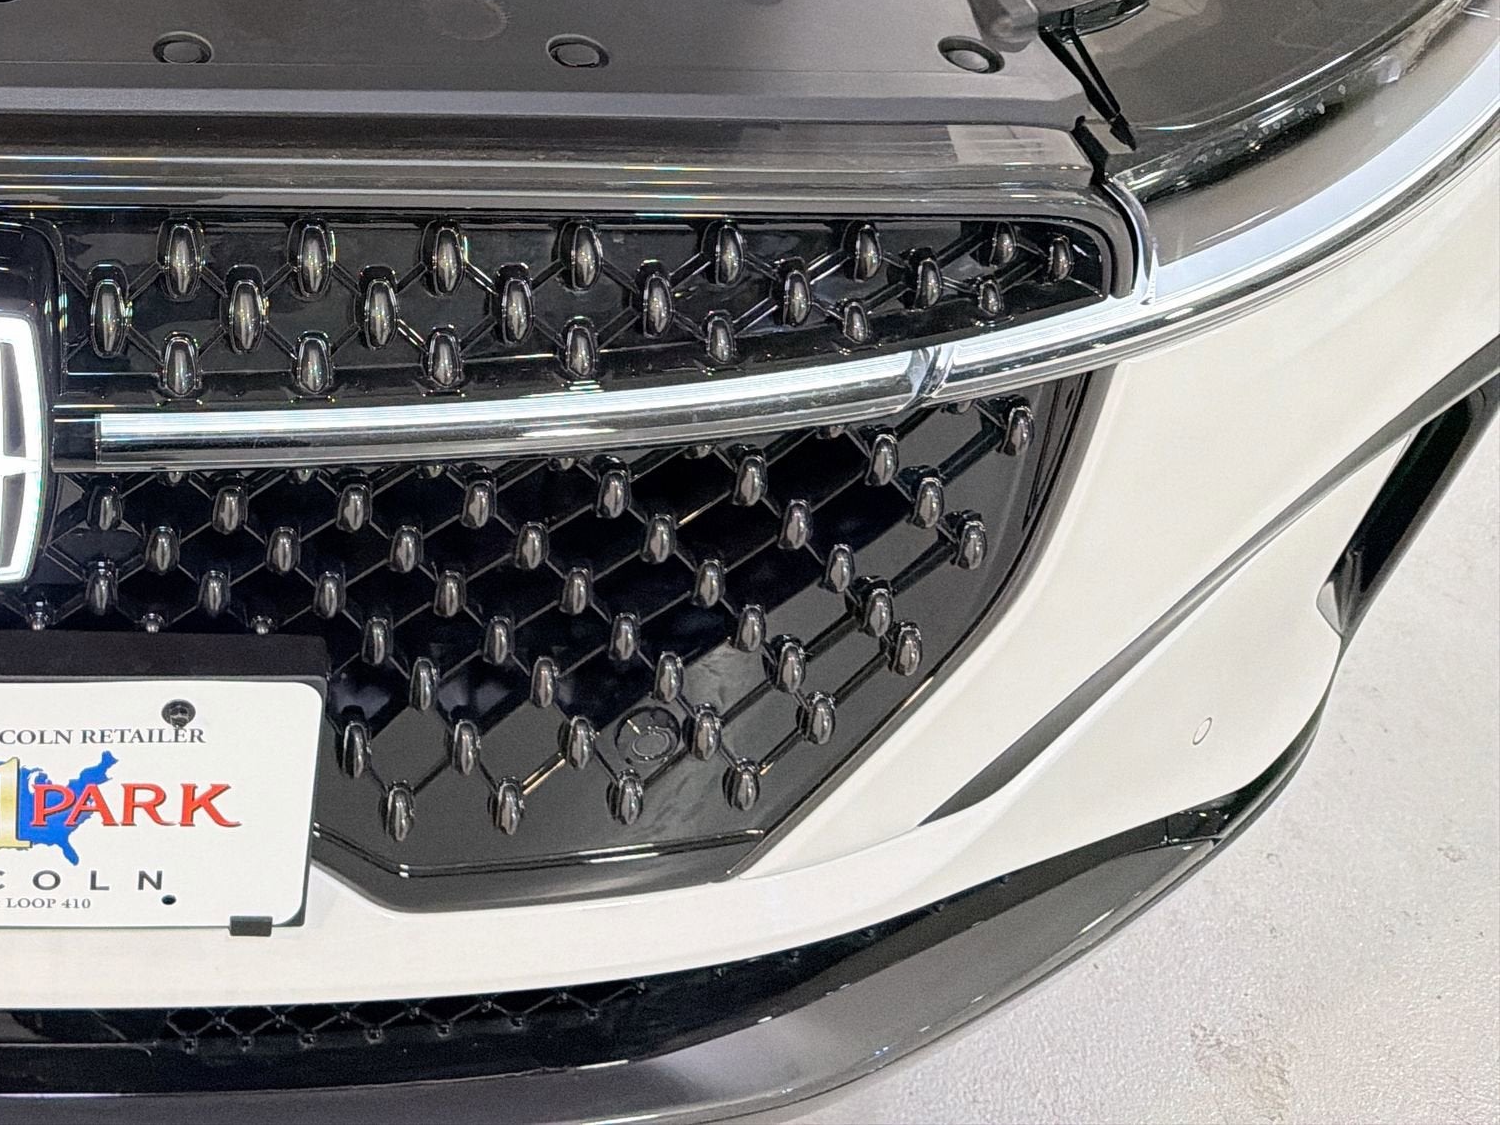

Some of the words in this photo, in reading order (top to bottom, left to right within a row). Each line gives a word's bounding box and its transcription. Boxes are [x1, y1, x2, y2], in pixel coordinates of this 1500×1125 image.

[80, 727, 207, 744] RETAILER
[30, 782, 243, 828] PARK
[6, 897, 57, 910] LOOP
[61, 897, 91, 910] 410
